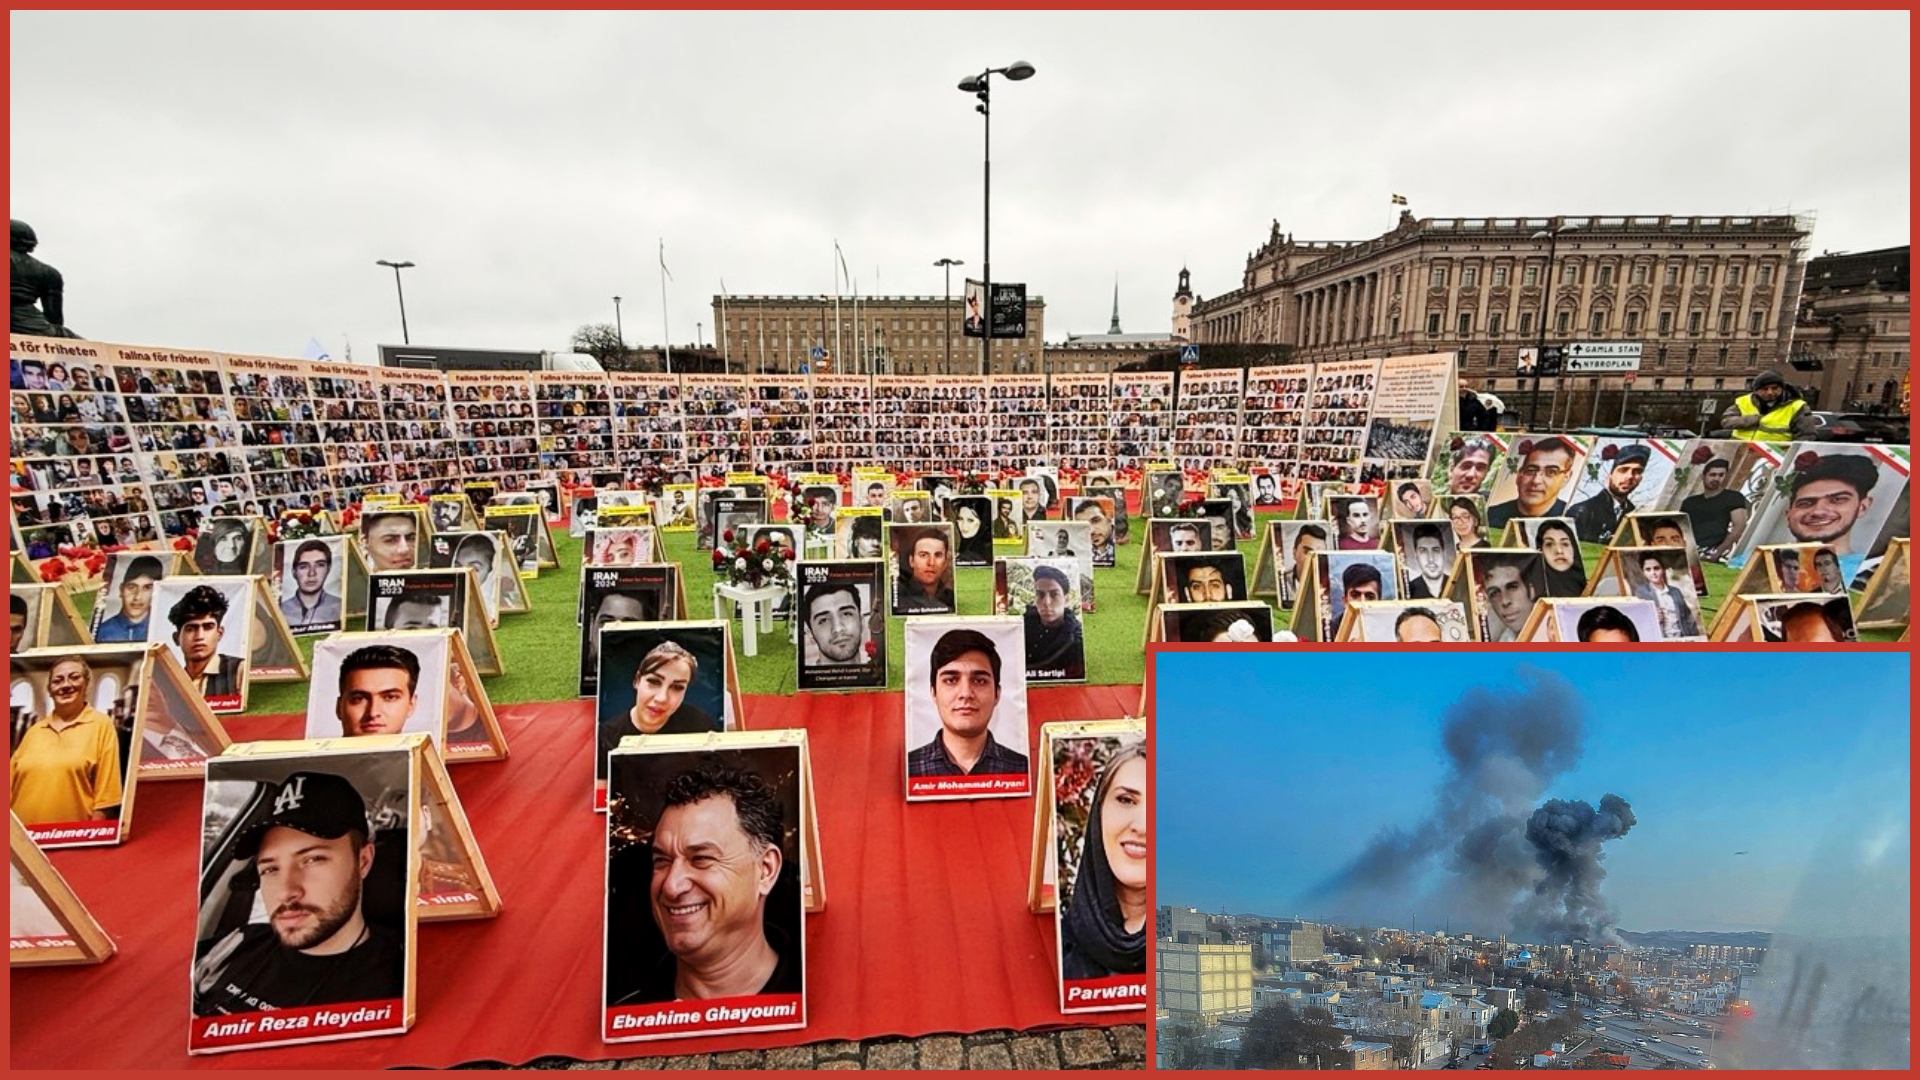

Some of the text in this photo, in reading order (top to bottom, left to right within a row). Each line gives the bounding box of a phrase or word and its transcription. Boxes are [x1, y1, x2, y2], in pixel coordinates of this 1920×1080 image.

[20, 341, 40, 354] för
[43, 343, 98, 358] friheten
[118, 350, 210, 365] fallna för friheten
[229, 358, 298, 372] fallna för friheten
[1583, 360, 1633, 368] NYBROPLAN
[592, 572, 619, 580] IRAN
[804, 567, 829, 576] IRAN
[378, 578, 405, 587] IRAN
[594, 580, 616, 588] 2024
[913, 779, 1025, 790] Amir Mohammad Aryani
[203, 1005, 392, 1038] Amir Reza Heydari
[612, 1002, 797, 1030] Ebrahime Ghayoumi
